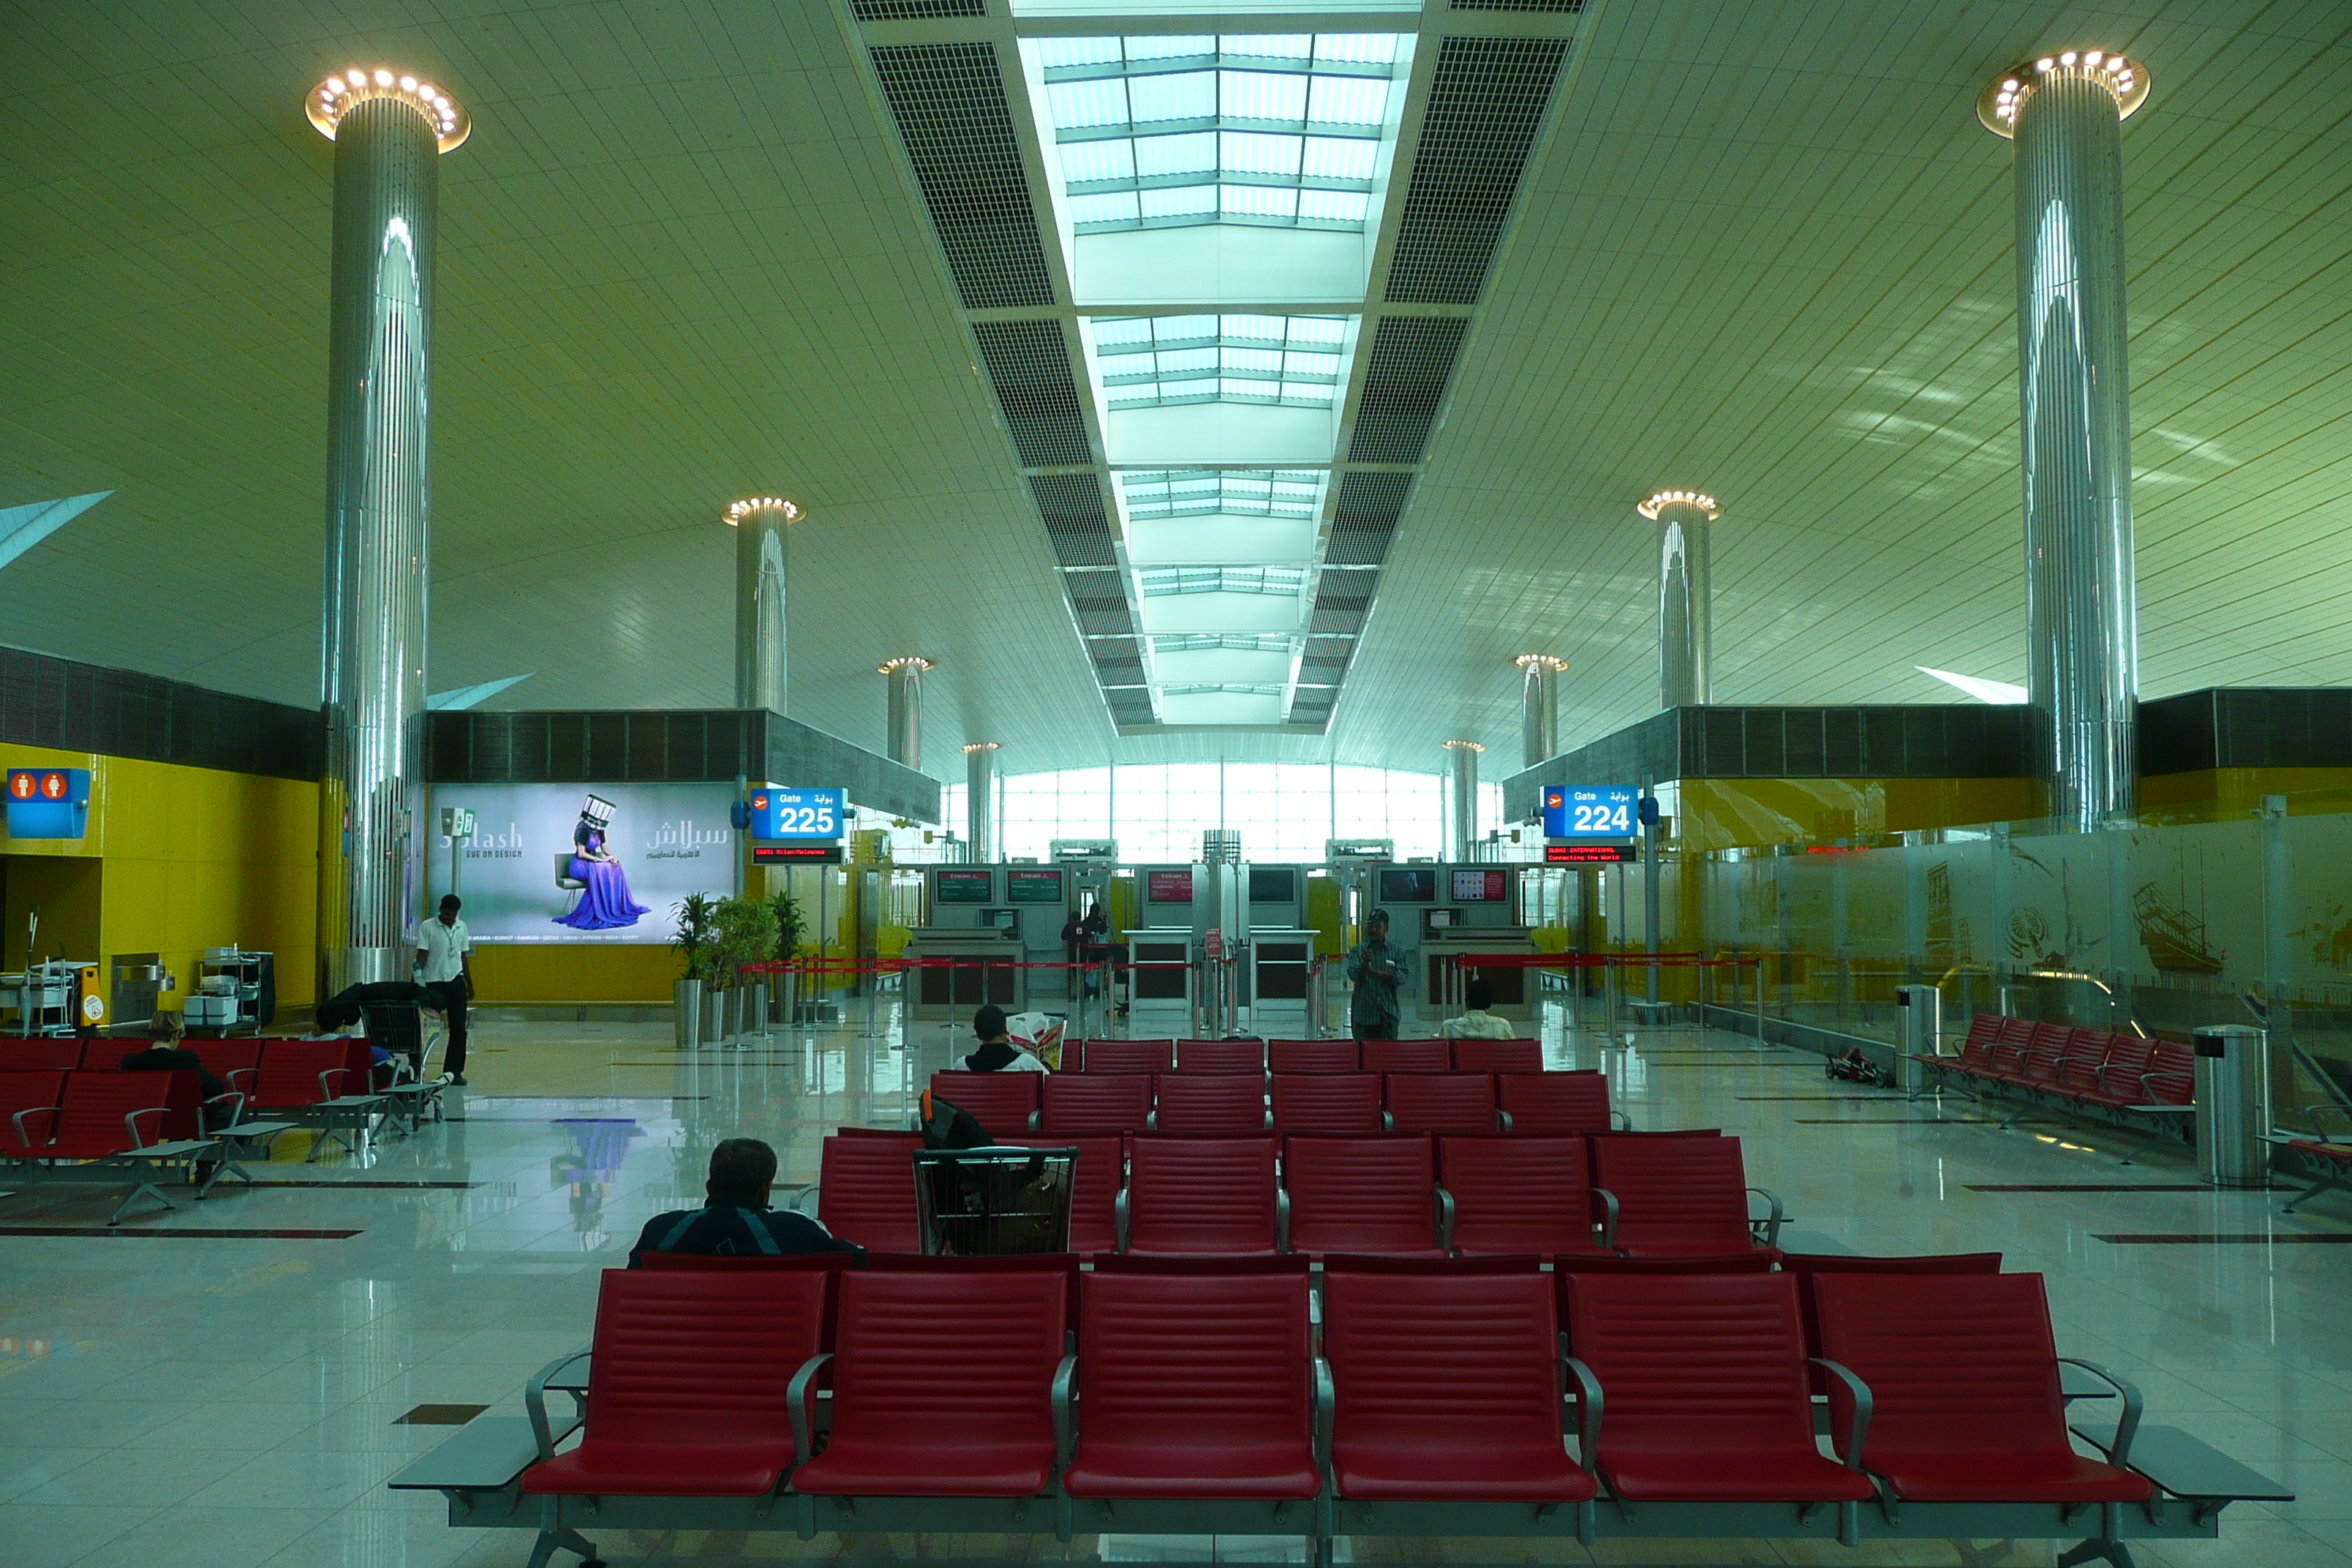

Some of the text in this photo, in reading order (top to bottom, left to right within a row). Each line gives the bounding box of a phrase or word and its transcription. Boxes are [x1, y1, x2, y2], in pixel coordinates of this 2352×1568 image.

[779, 794, 802, 803] Gate
[814, 794, 834, 804] بوابة
[1574, 792, 1597, 801] Gate
[1610, 791, 1630, 802] بوابة
[780, 807, 834, 833] 225
[1574, 805, 1630, 831] 224
[647, 821, 728, 849] سبلاش
[467, 851, 522, 859] EYE ON DESIGN
